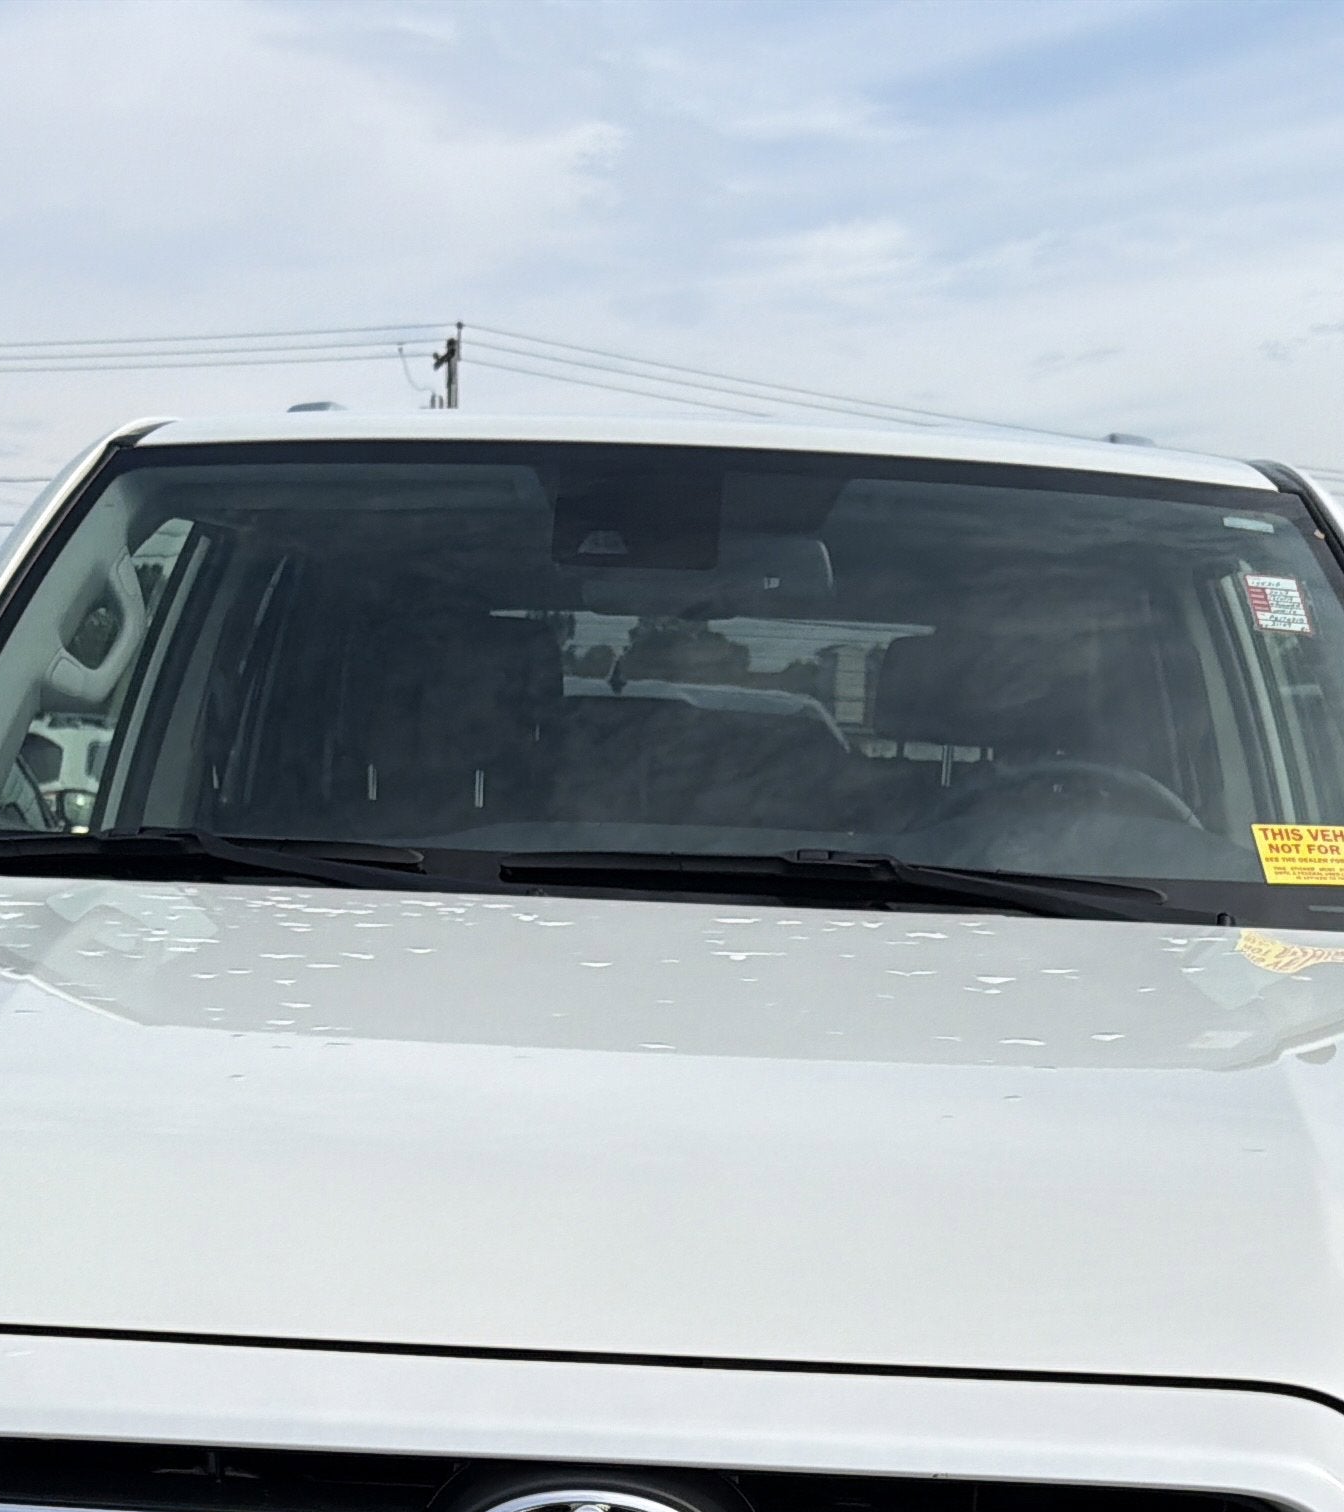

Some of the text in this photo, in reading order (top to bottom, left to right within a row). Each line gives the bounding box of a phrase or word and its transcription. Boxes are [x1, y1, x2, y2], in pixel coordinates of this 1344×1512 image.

[1259, 828, 1304, 842] THIS
[1268, 844, 1301, 855] NOT
[1307, 844, 1341, 856] FOR
